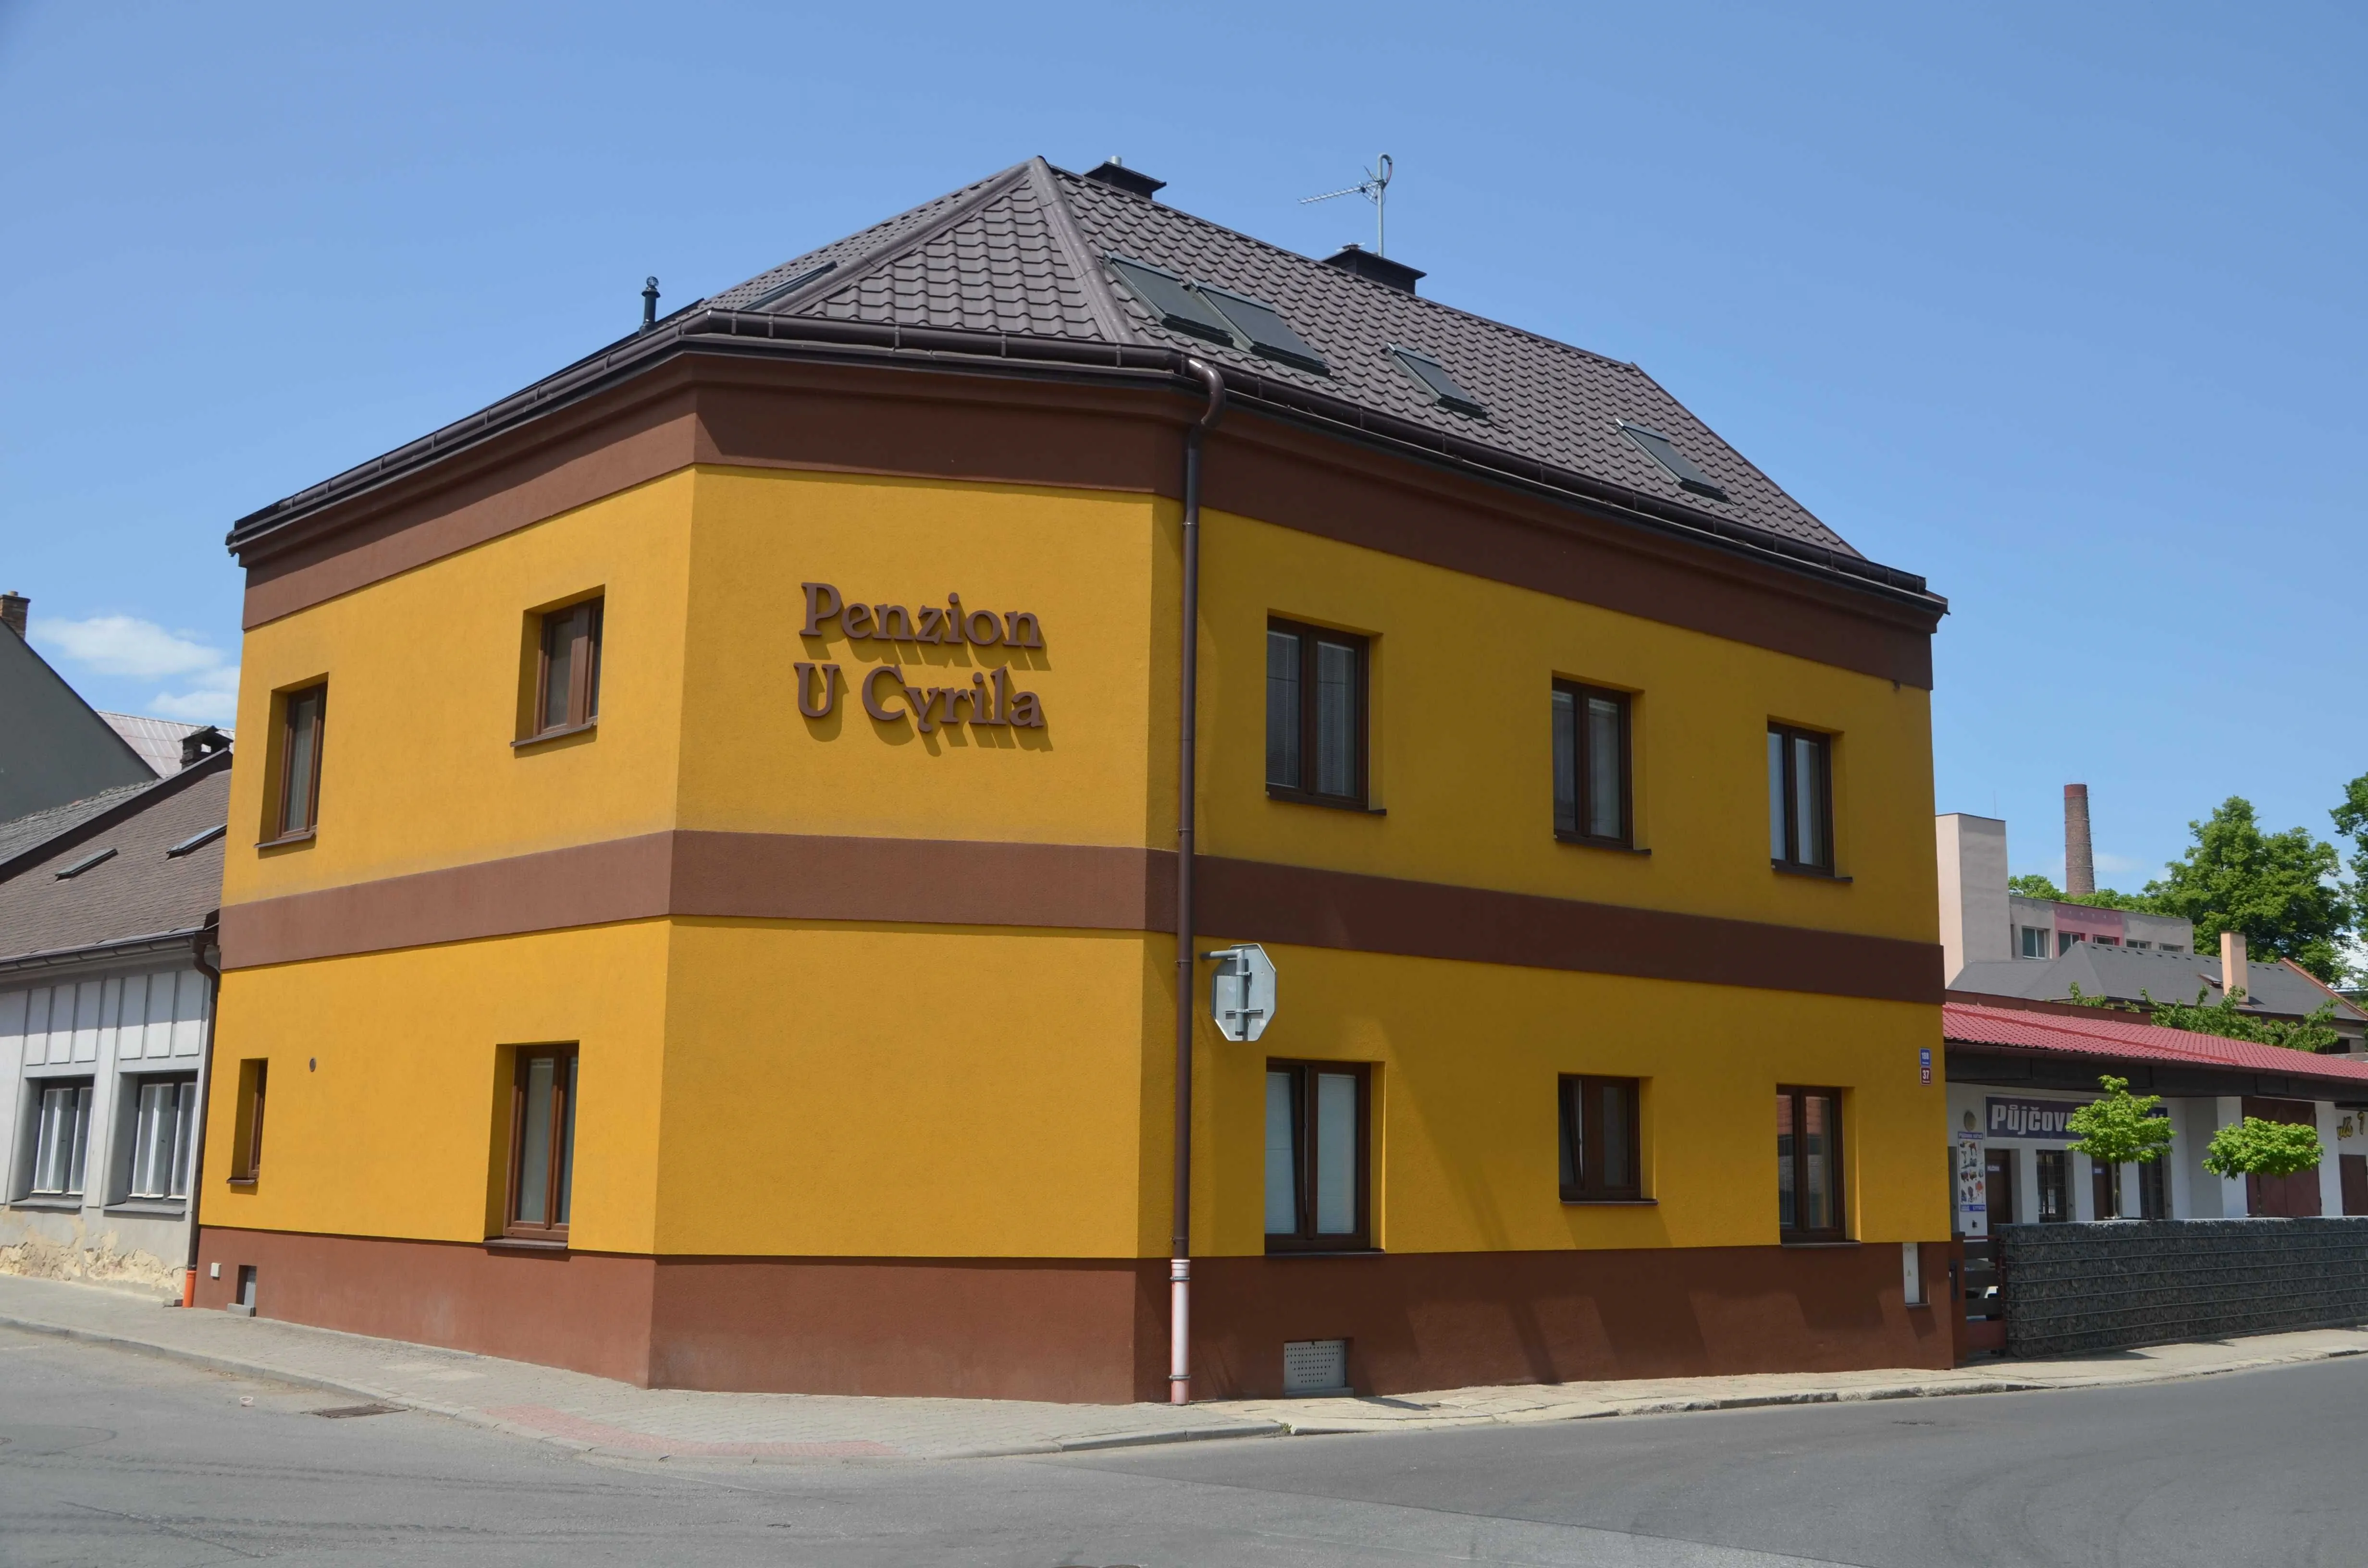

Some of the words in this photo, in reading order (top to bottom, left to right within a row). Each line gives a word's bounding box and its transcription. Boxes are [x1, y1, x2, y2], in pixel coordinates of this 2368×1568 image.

[799, 581, 1043, 648] Penzion
[793, 662, 840, 718] U
[862, 664, 1044, 733] Cyrila
[1922, 1070, 1930, 1079] 37
